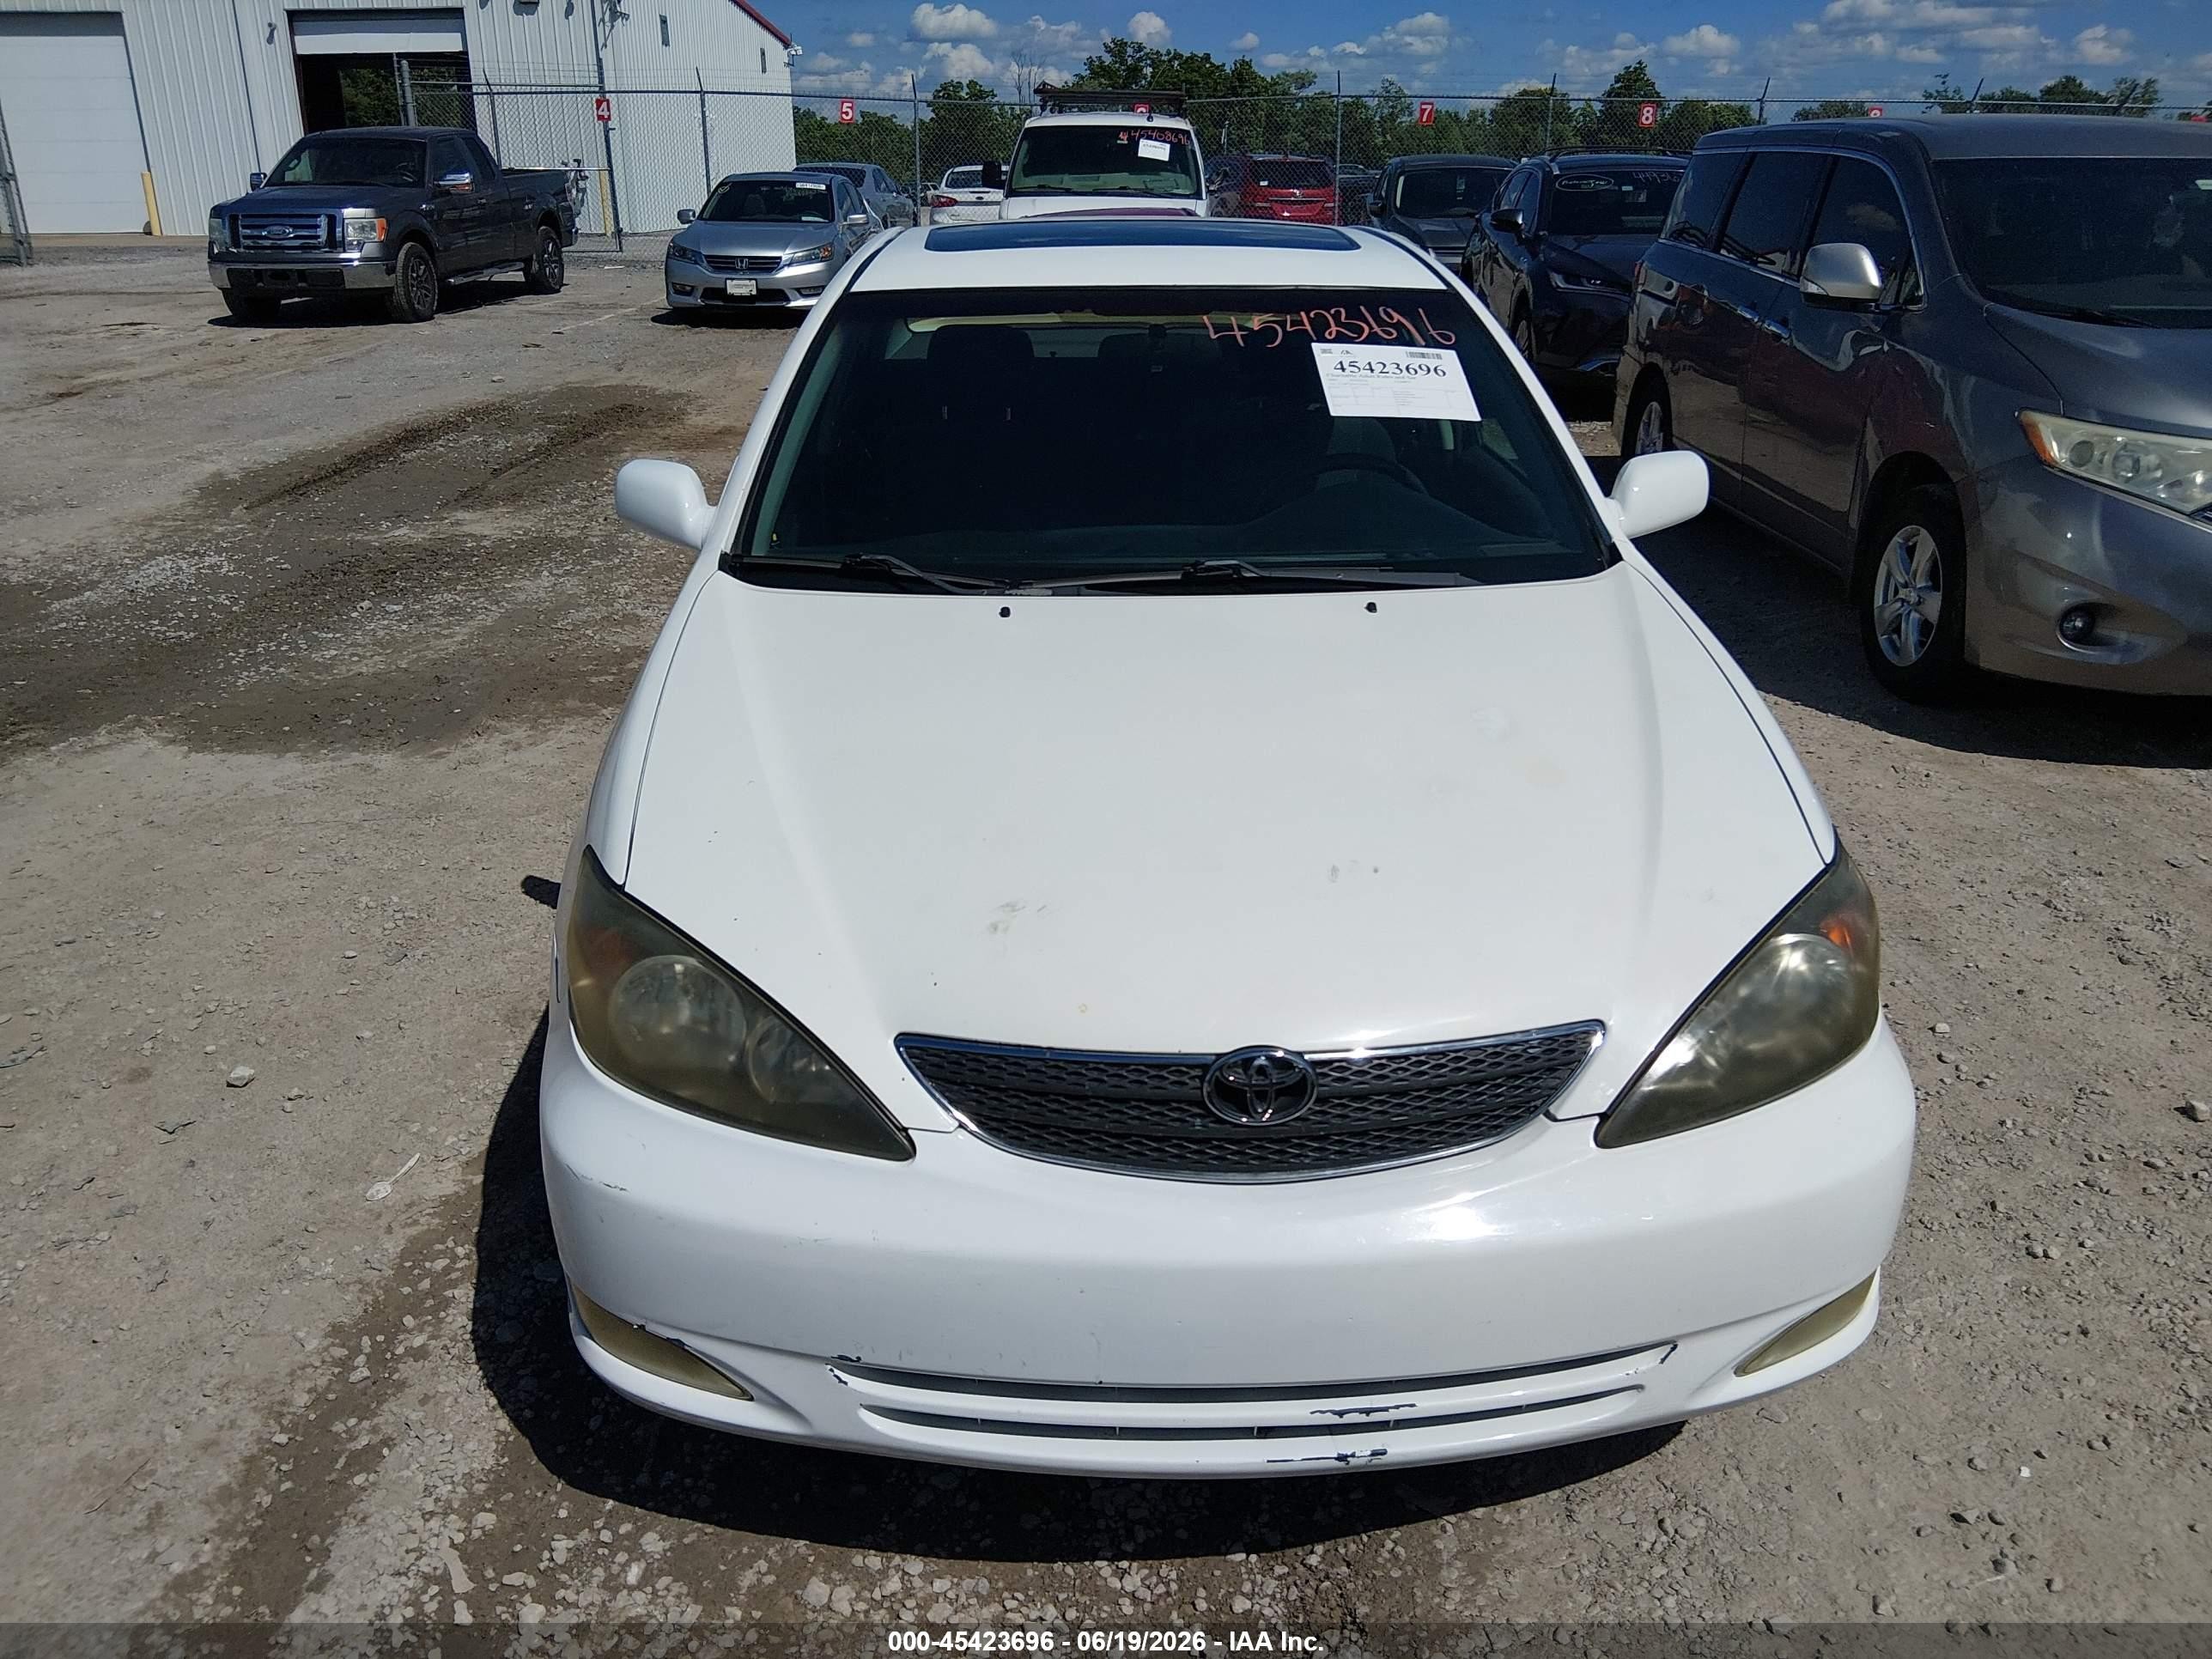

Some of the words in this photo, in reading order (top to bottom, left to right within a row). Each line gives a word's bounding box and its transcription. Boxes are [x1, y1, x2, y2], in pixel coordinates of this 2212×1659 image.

[598, 101, 610, 118] 4
[842, 102, 853, 120] 5
[1421, 105, 1432, 122] 7
[1641, 106, 1654, 125] 8
[1203, 305, 1456, 348] 45423696
[1334, 360, 1447, 378] 45423696
